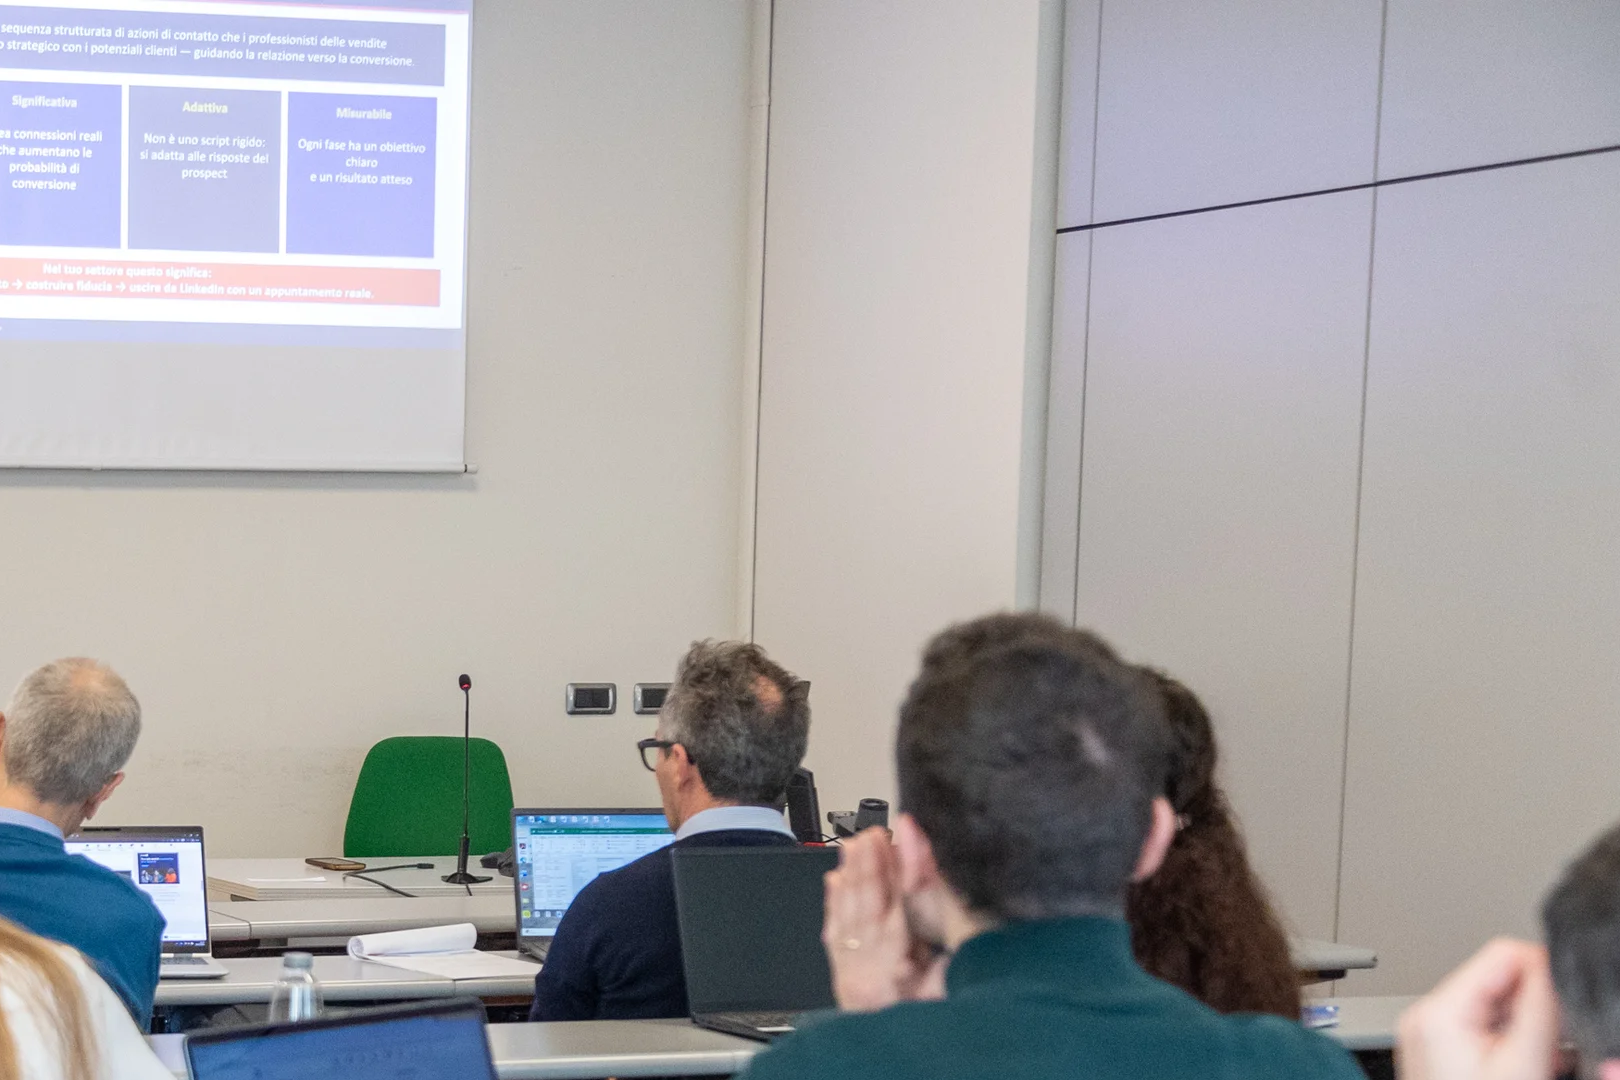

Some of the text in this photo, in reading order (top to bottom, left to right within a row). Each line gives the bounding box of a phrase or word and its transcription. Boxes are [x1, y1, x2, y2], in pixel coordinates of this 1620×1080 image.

[1, 25, 51, 37] sequenza
[54, 24, 112, 37] strutturata
[115, 26, 125, 39] di
[128, 27, 158, 40] azioni
[161, 28, 171, 41] di
[174, 29, 218, 42] contatto
[221, 31, 240, 44] che
[248, 33, 318, 49] professionisti
[320, 36, 345, 48] delle
[348, 37, 387, 50] vendite
[6, 38, 60, 53] strategico
[63, 43, 82, 52] con
[91, 42, 142, 57] potenziali
[145, 44, 177, 56] clienti
[194, 46, 243, 61] guidando
[246, 48, 254, 60] la
[257, 49, 305, 62] relazione
[307, 54, 336, 63] verso
[339, 52, 348, 64] la
[350, 53, 415, 66] conversione.
[12, 95, 78, 108] Significativa
[182, 101, 228, 113] Adattiva
[336, 108, 392, 120] Misurabile
[14, 130, 76, 141] connessioni
[79, 131, 103, 141] reali
[144, 133, 265, 149] Non è uno script rigido:
[18, 148, 80, 157] aumentano
[82, 147, 93, 158] le
[298, 139, 426, 153] Ogni fase ha un obiettivo
[140, 150, 269, 163] si adatta alle risposte del
[346, 157, 378, 167] chiaro
[9, 163, 80, 174] probabilità di
[181, 168, 228, 179] prospect
[12, 179, 77, 190] conversione
[310, 172, 413, 185] e un risultato atteso
[43, 263, 212, 281] Nel tuo settore questo significa:
[26, 280, 73, 291] costruire
[76, 281, 112, 292] fiducia
[129, 282, 161, 293] uscire
[164, 283, 176, 293] da
[180, 283, 224, 294] LinkedIn
[227, 287, 246, 295] con
[249, 288, 262, 296] un
[265, 286, 342, 300] appuntamento
